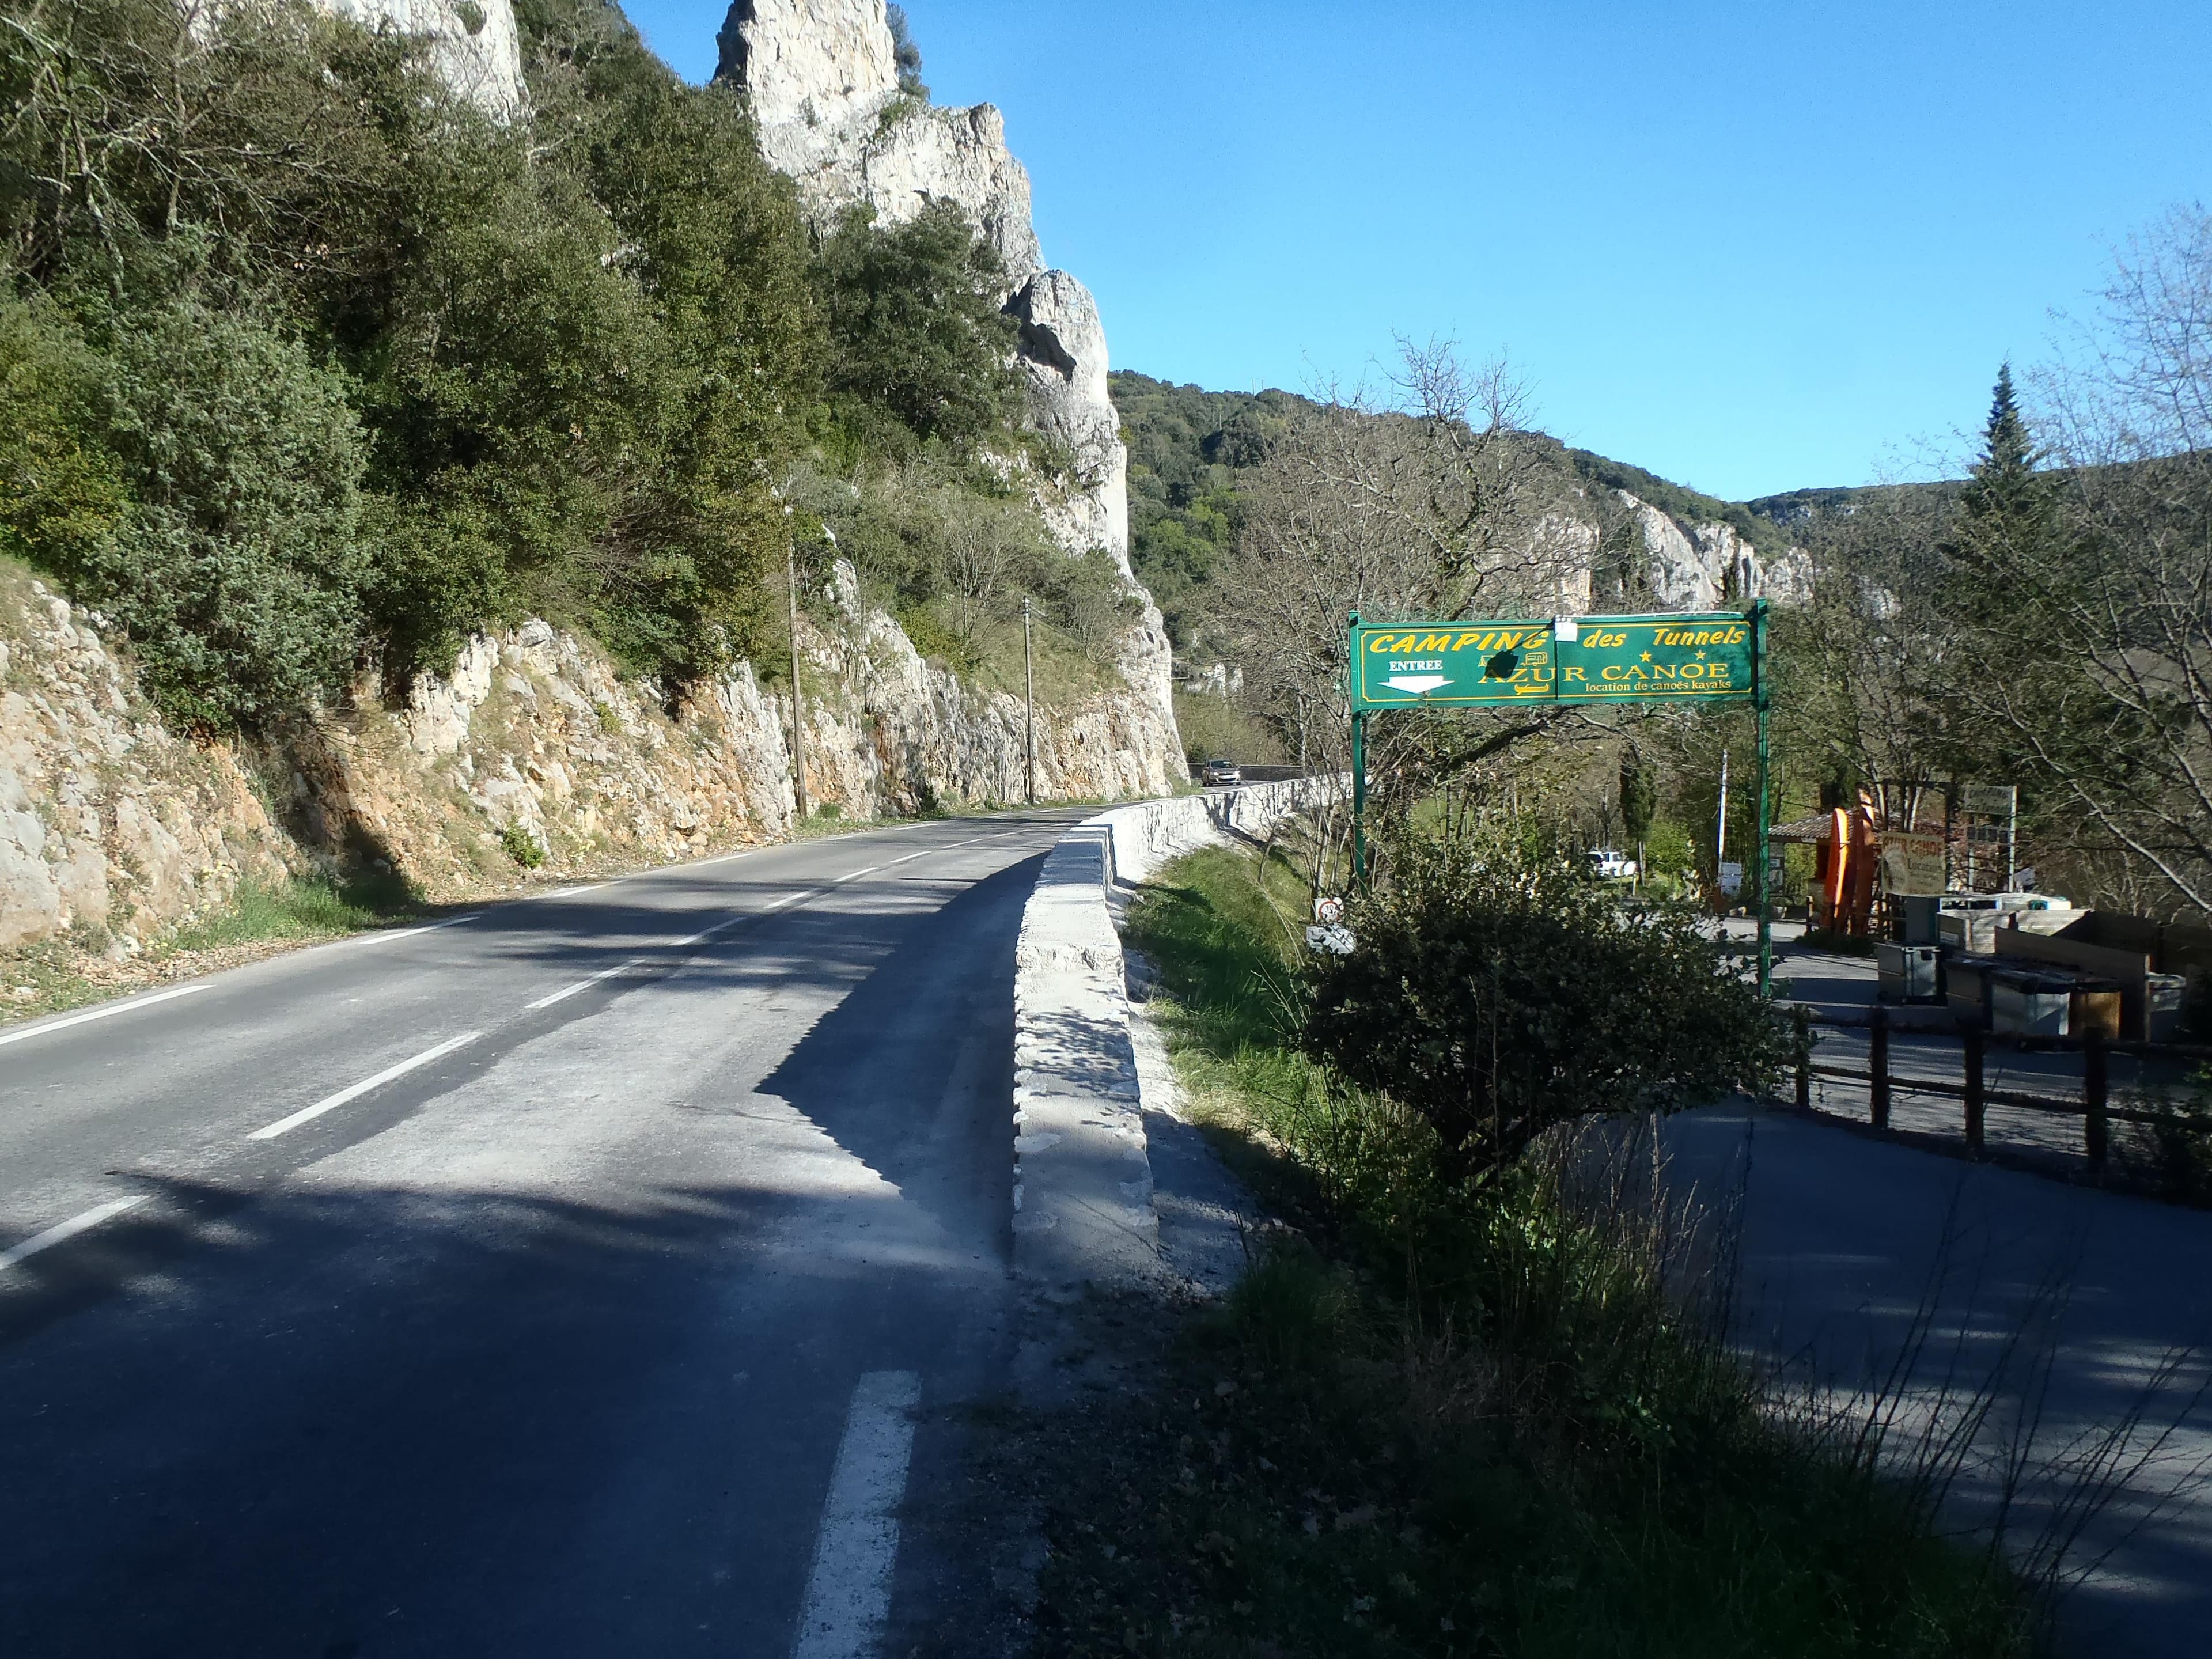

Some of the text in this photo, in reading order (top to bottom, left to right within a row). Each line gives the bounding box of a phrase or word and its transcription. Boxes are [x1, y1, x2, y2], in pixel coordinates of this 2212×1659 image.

[1370, 626, 1746, 653] CAMPING des Tunnels
[1389, 660, 1442, 672] ENTREE
[1601, 663, 1730, 680] CANOE
[1585, 680, 1732, 693] location de canoës kayaks
